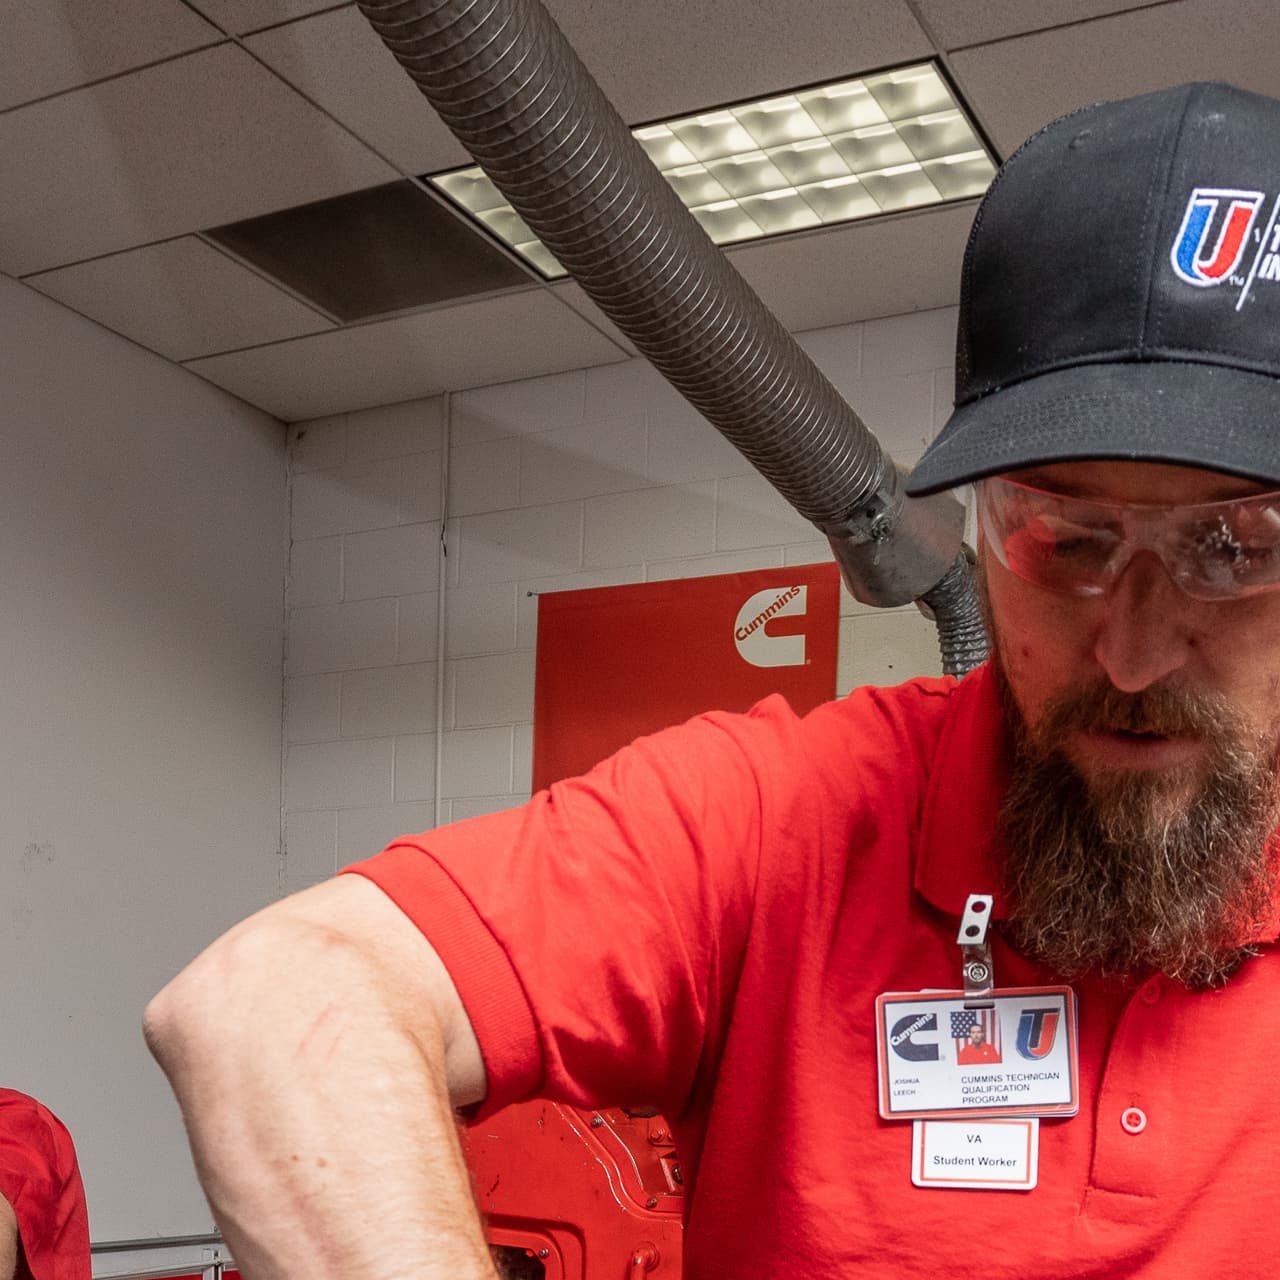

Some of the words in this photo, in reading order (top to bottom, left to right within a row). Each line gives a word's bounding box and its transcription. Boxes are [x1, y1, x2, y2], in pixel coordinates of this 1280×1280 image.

[735, 584, 801, 641] Cummins
[891, 1013, 935, 1046] Cummins
[961, 1074, 1003, 1085] CUMMINS
[1006, 1072, 1060, 1083] TECHNICIAN
[961, 1083, 1030, 1096] QUALIFICATION
[962, 1095, 1009, 1105] PROGRAM
[966, 1134, 982, 1144] VA
[933, 1155, 975, 1166] Student
[978, 1156, 1017, 1168] Worker
